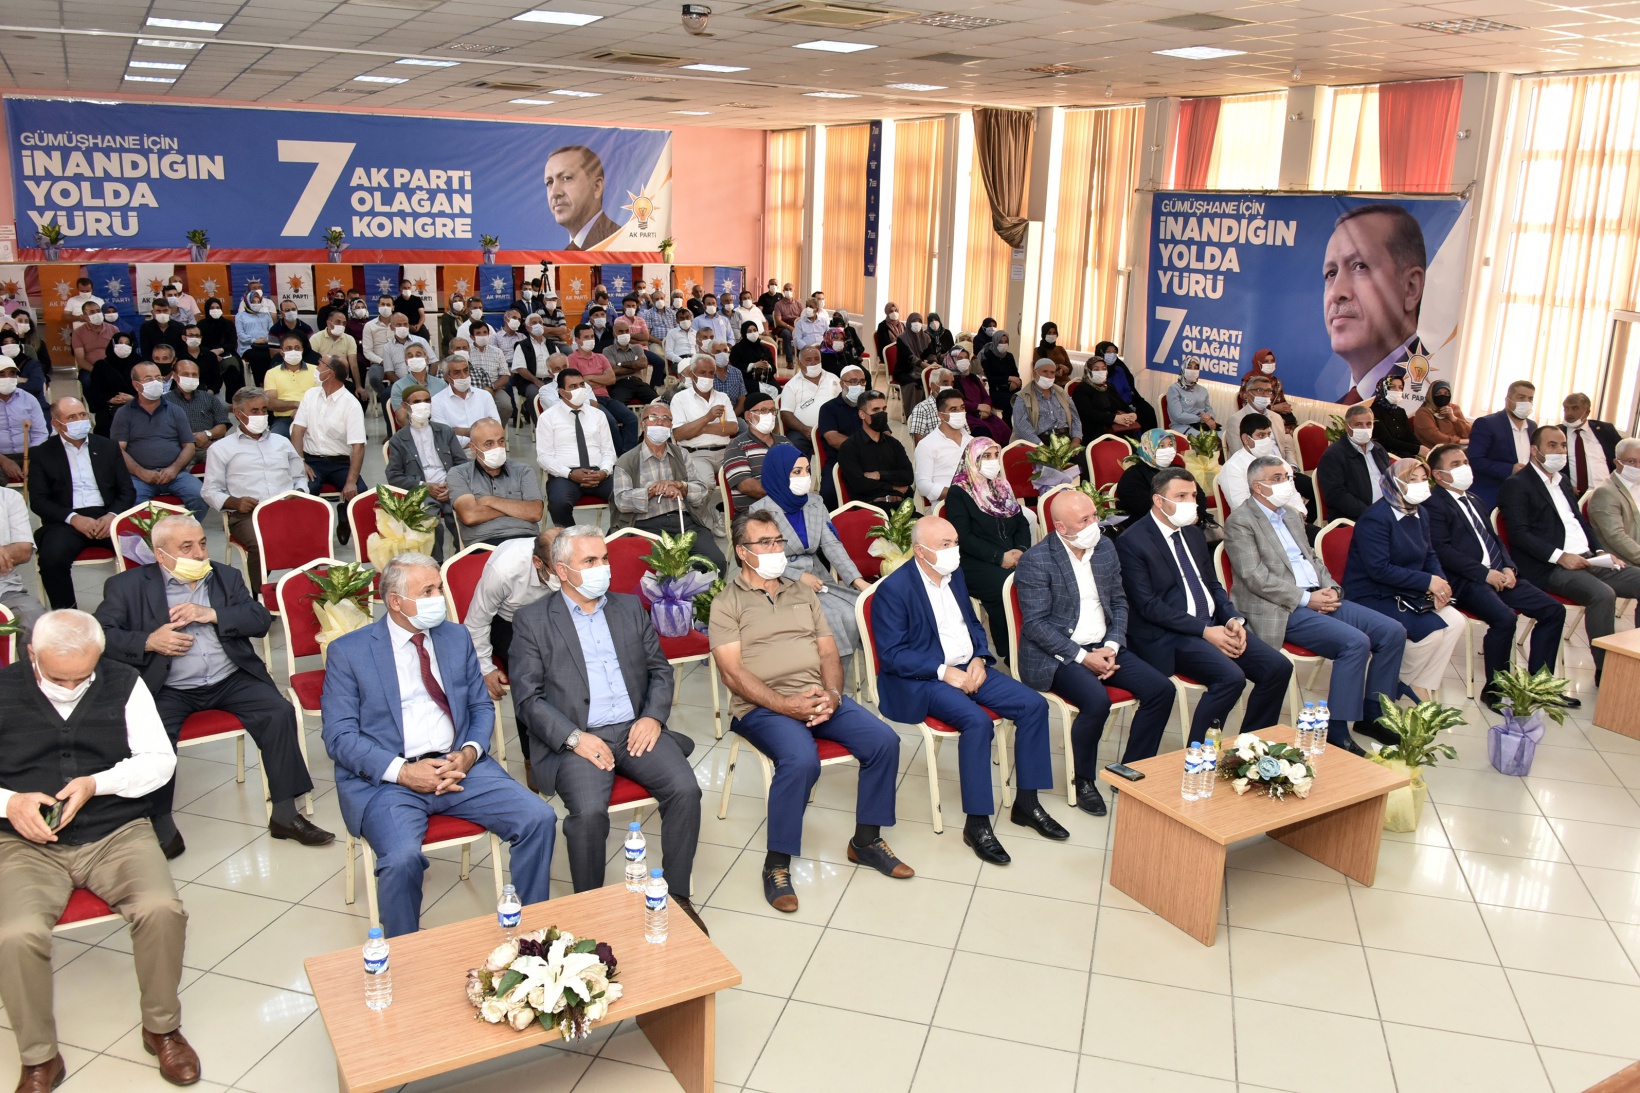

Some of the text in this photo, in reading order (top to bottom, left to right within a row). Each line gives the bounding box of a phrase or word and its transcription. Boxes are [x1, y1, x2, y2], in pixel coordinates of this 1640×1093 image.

[20, 130, 179, 153] GÜMÜŞHANE İÇİN
[349, 166, 473, 191] AK PARTİ
[23, 180, 160, 208] YOLDA
[350, 190, 473, 215] OLAĞAN
[1161, 197, 1266, 217] GÜMÜŞHANE İÇİN
[27, 210, 140, 237] YÜRÜ
[351, 216, 473, 239] KONGRE
[1158, 243, 1241, 273] YOLDA
[1157, 270, 1225, 300] YÜRÜ
[1181, 324, 1243, 345] AK PARTİ
[1181, 338, 1241, 361] OLAĞAN
